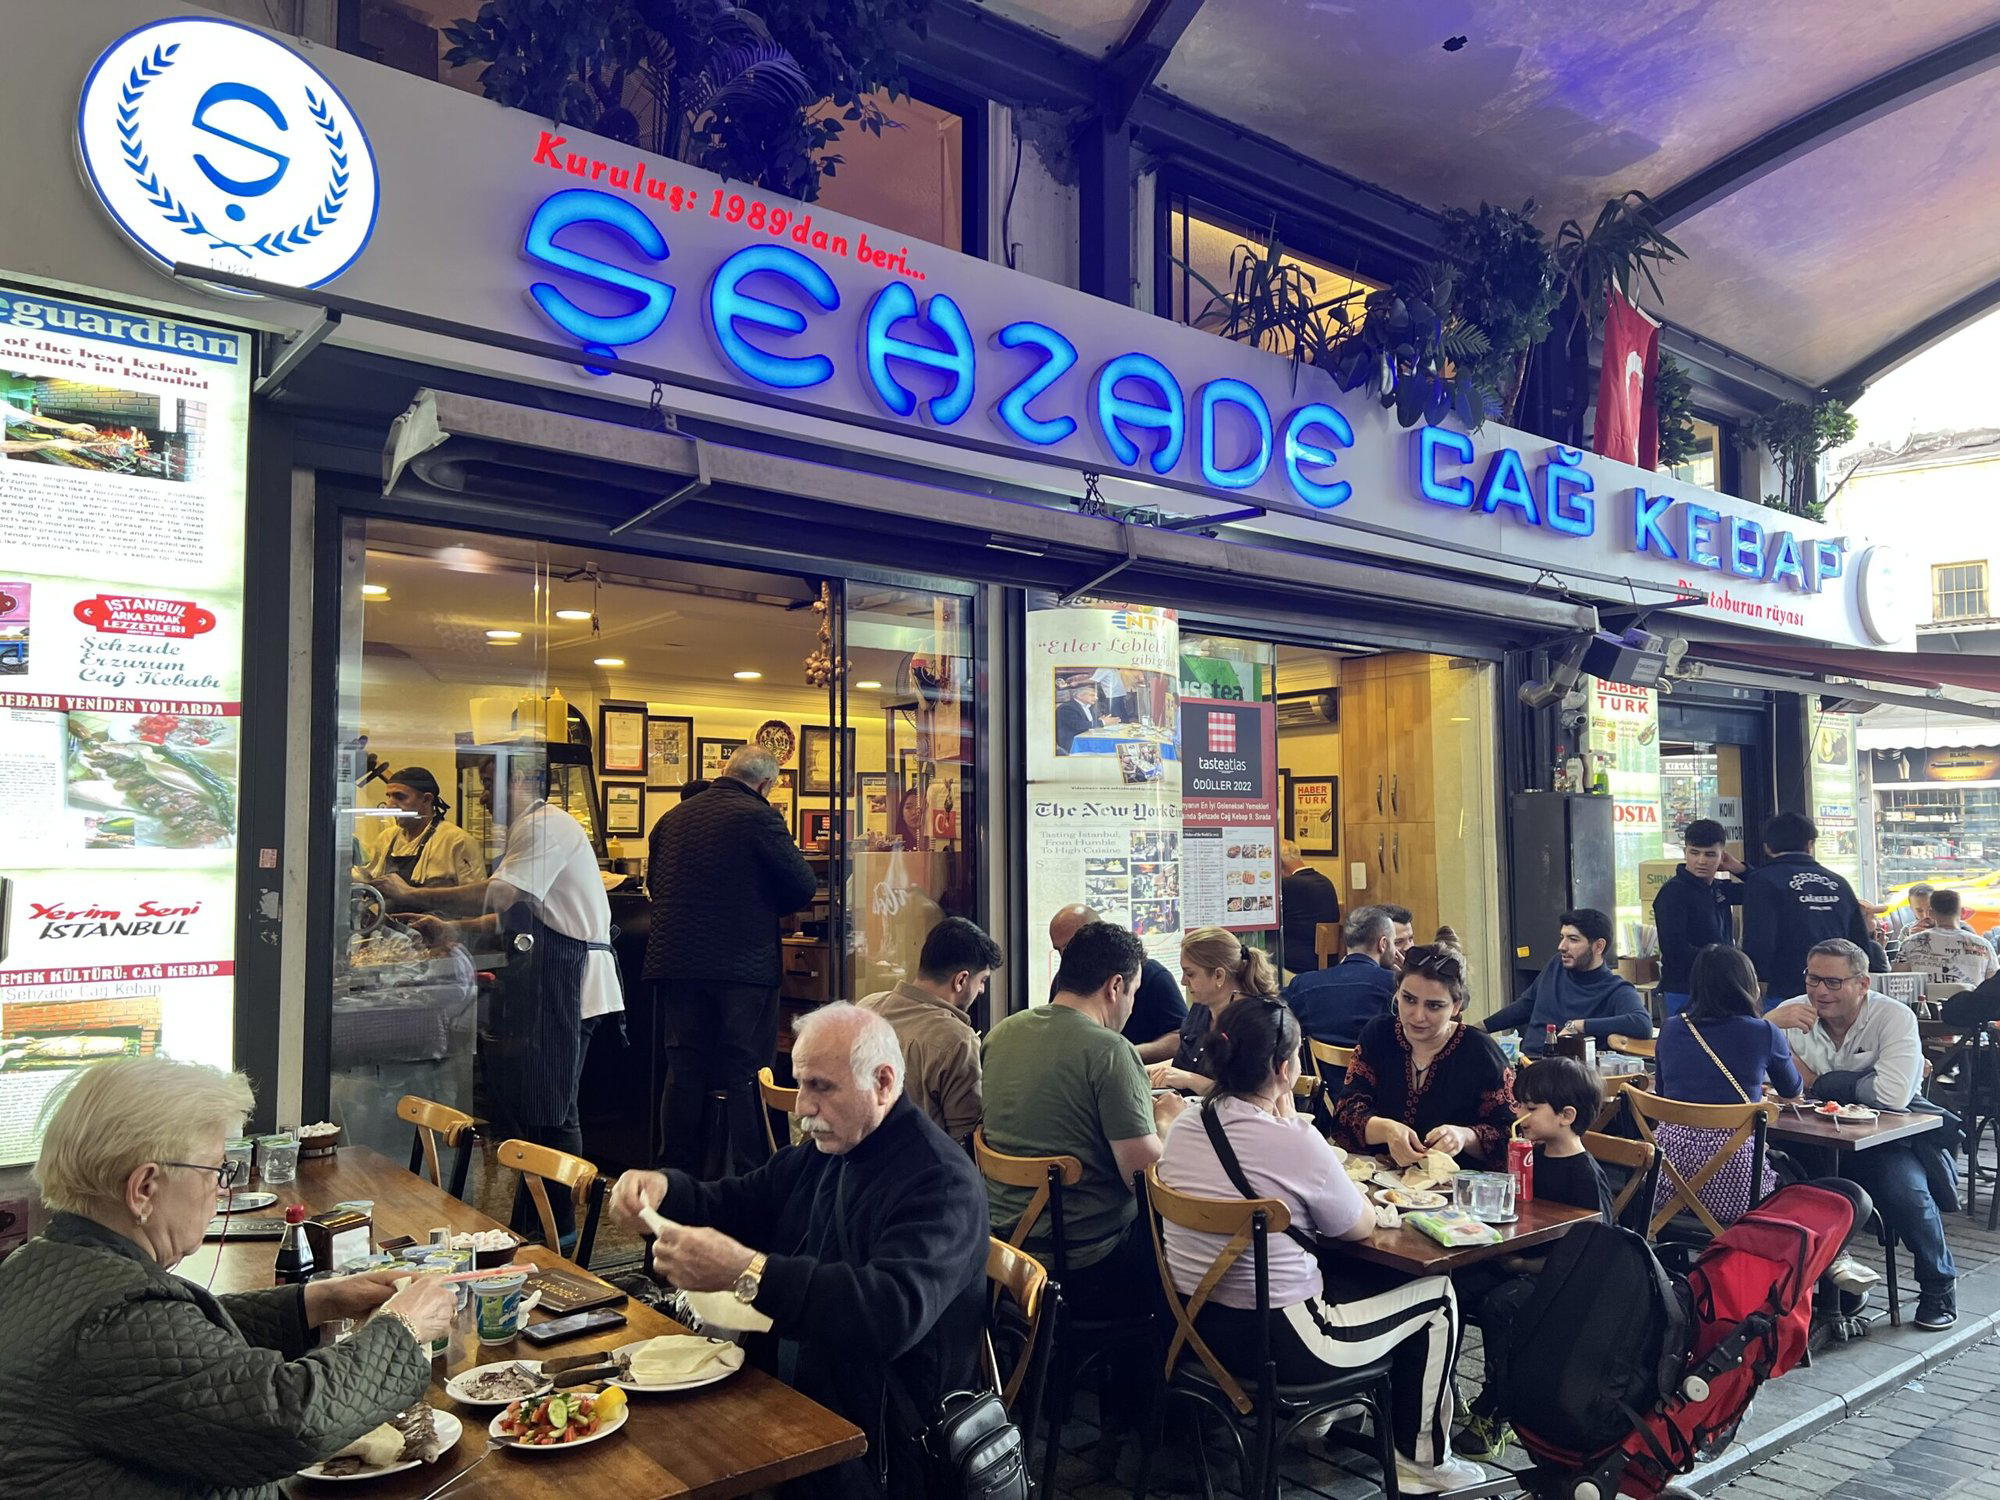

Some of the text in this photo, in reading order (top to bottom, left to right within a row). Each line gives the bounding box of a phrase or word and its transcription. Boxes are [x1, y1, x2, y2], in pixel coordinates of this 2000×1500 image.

[532, 130, 927, 281] Kuruluş: 1989'dan beri...
[4, 337, 198, 377] of the best kebab
[524, 187, 1355, 509] ŞEHZADE
[95, 363, 114, 374] in
[124, 368, 210, 389] Istanbul
[1418, 424, 1844, 594] CAĞ KEBAP
[1704, 590, 1804, 627] toburun rüyası
[111, 612, 181, 625] ARKA SOKAK
[1126, 615, 1166, 631] NT
[80, 652, 185, 672] Erzurum
[1180, 679, 1243, 701] usetea
[1596, 679, 1648, 696] HABER
[65, 696, 136, 714] YENİDEN
[140, 700, 224, 717] YOLLARDA
[1597, 696, 1649, 715] TURK
[1199, 757, 1247, 771] tasteatlas
[1193, 778, 1232, 791] ÖDÜLLER
[1233, 780, 1252, 791] 2022
[1298, 786, 1327, 794] HABER
[1035, 802, 1077, 819] The
[1082, 802, 1129, 818] New
[1132, 803, 1168, 822] York
[1039, 830, 1076, 839] Tasting
[1725, 825, 1743, 840] NIYOR
[1055, 846, 1082, 855] High
[1083, 846, 1121, 854] Cuisine
[1647, 873, 1673, 885] SIRM
[28, 900, 202, 921] Yerim Seni
[132, 963, 162, 978] CAĞ
[167, 963, 219, 977] KEBAP
